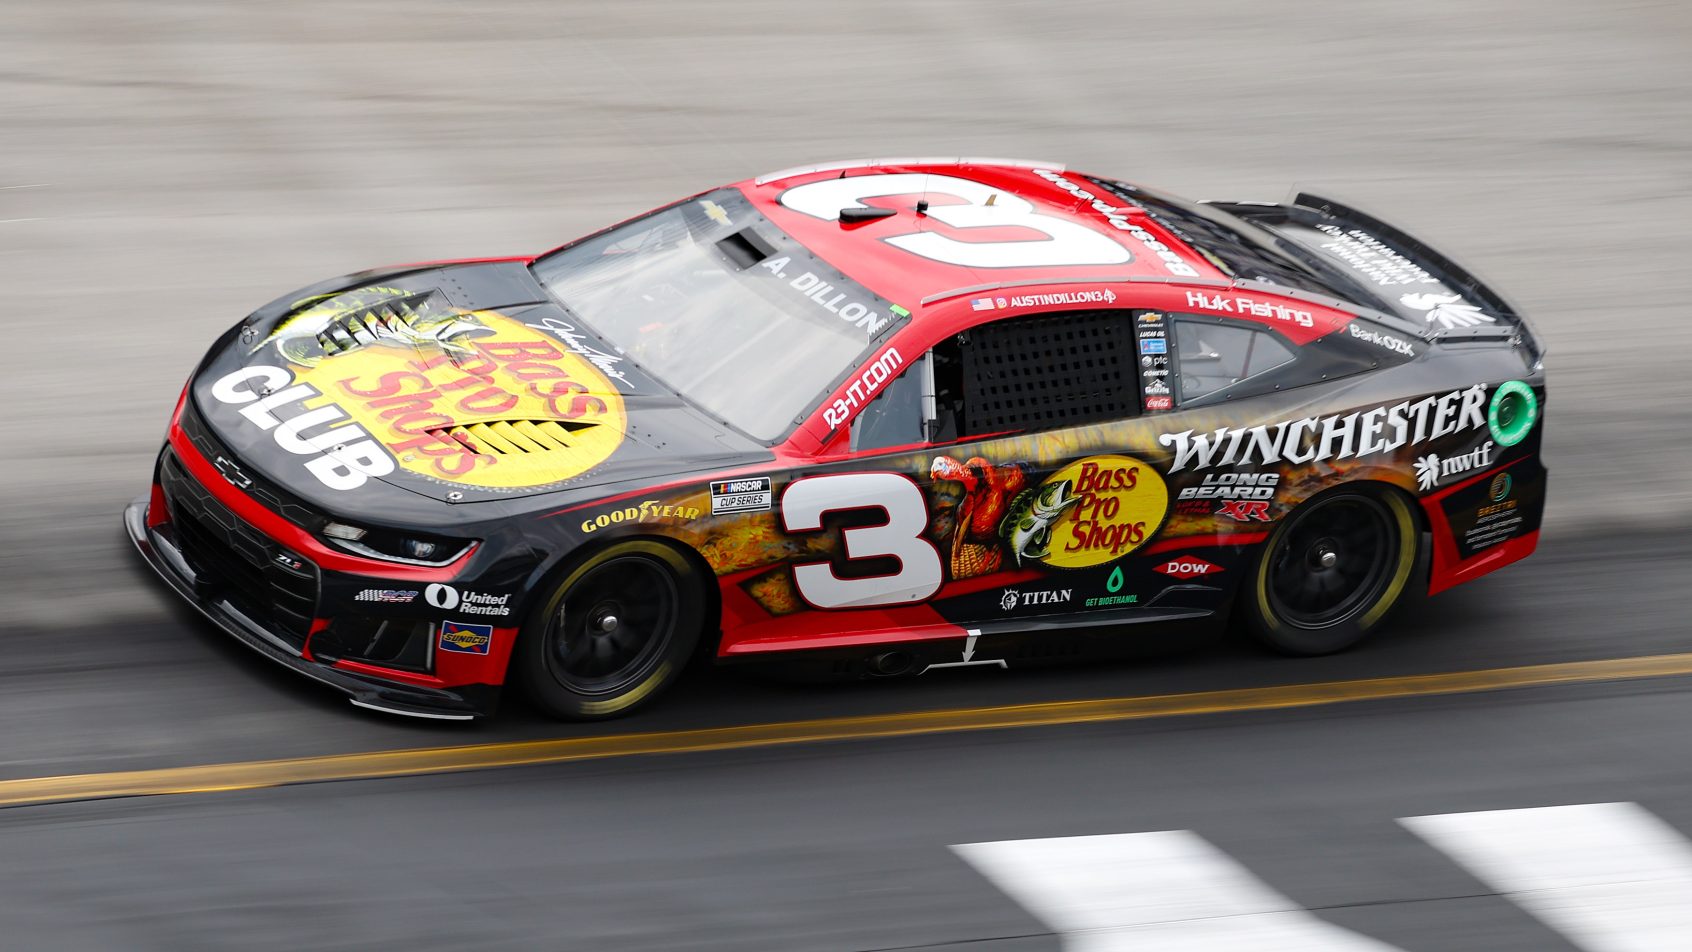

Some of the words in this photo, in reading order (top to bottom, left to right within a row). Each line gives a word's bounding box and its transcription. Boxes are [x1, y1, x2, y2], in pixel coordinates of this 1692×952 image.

[780, 173, 1132, 268] 3
[762, 256, 792, 279] A.
[789, 272, 884, 335] DILLON
[1011, 291, 1103, 307] AUSTINDILLON3
[1186, 291, 1234, 312] Huk
[1236, 298, 1314, 327] Fishing
[1153, 356, 1168, 366] ptc
[405, 355, 519, 414] Pro
[473, 340, 609, 420] Bass
[823, 348, 903, 430] R3-IT.COM
[211, 365, 395, 491] CLUB
[339, 371, 498, 476] Shops
[1159, 386, 1487, 475] WINCHESTER
[1440, 440, 1494, 477] nwtf
[730, 480, 762, 493] NASCAR
[1073, 462, 1139, 494] Bass
[1202, 473, 1280, 486] LONG
[720, 497, 736, 507] CUP
[736, 494, 763, 506] SERIES
[1070, 492, 1120, 522] Pro
[1214, 500, 1272, 522] XR
[781, 471, 945, 612] 3
[1064, 520, 1146, 556] Shops
[459, 602, 510, 616] Rentals
[461, 590, 508, 605] United
[1022, 589, 1072, 605] TITAN
[1085, 598, 1098, 607] GET
[1098, 594, 1139, 606] BIOETHANOL
[444, 633, 487, 645] SUNOCO
